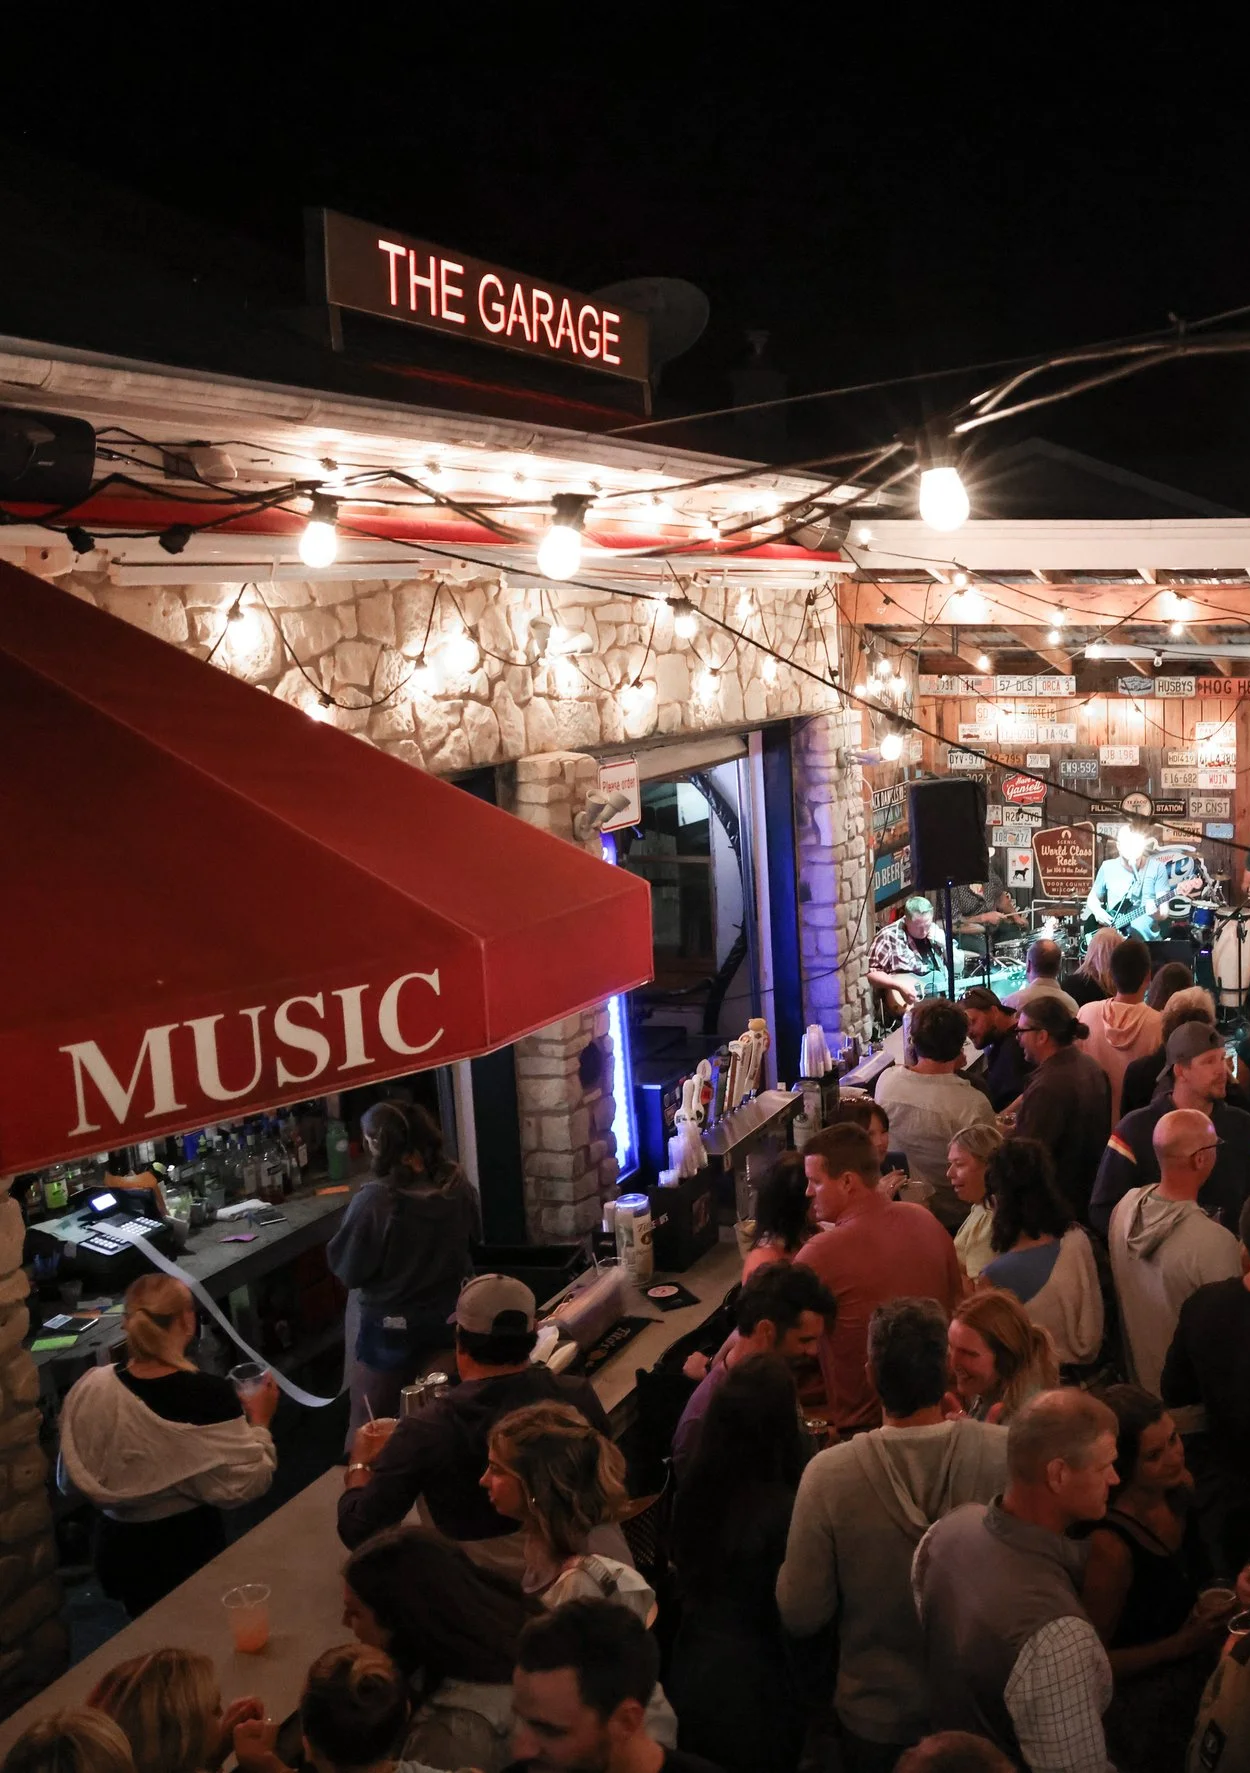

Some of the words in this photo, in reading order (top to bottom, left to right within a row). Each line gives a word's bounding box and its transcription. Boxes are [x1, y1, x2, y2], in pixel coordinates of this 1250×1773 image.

[378, 239, 466, 324] THE
[478, 273, 621, 365] GARAGE
[1157, 681, 1193, 692] HUSBYS
[1203, 680, 1232, 695] HOG
[1155, 804, 1184, 812] STATION
[1191, 802, 1203, 813] SP
[1041, 845, 1068, 856] World
[1069, 845, 1093, 856] Class
[1056, 855, 1078, 866] Rock
[881, 862, 901, 887] BEER
[58, 968, 445, 1138] MUSIC
